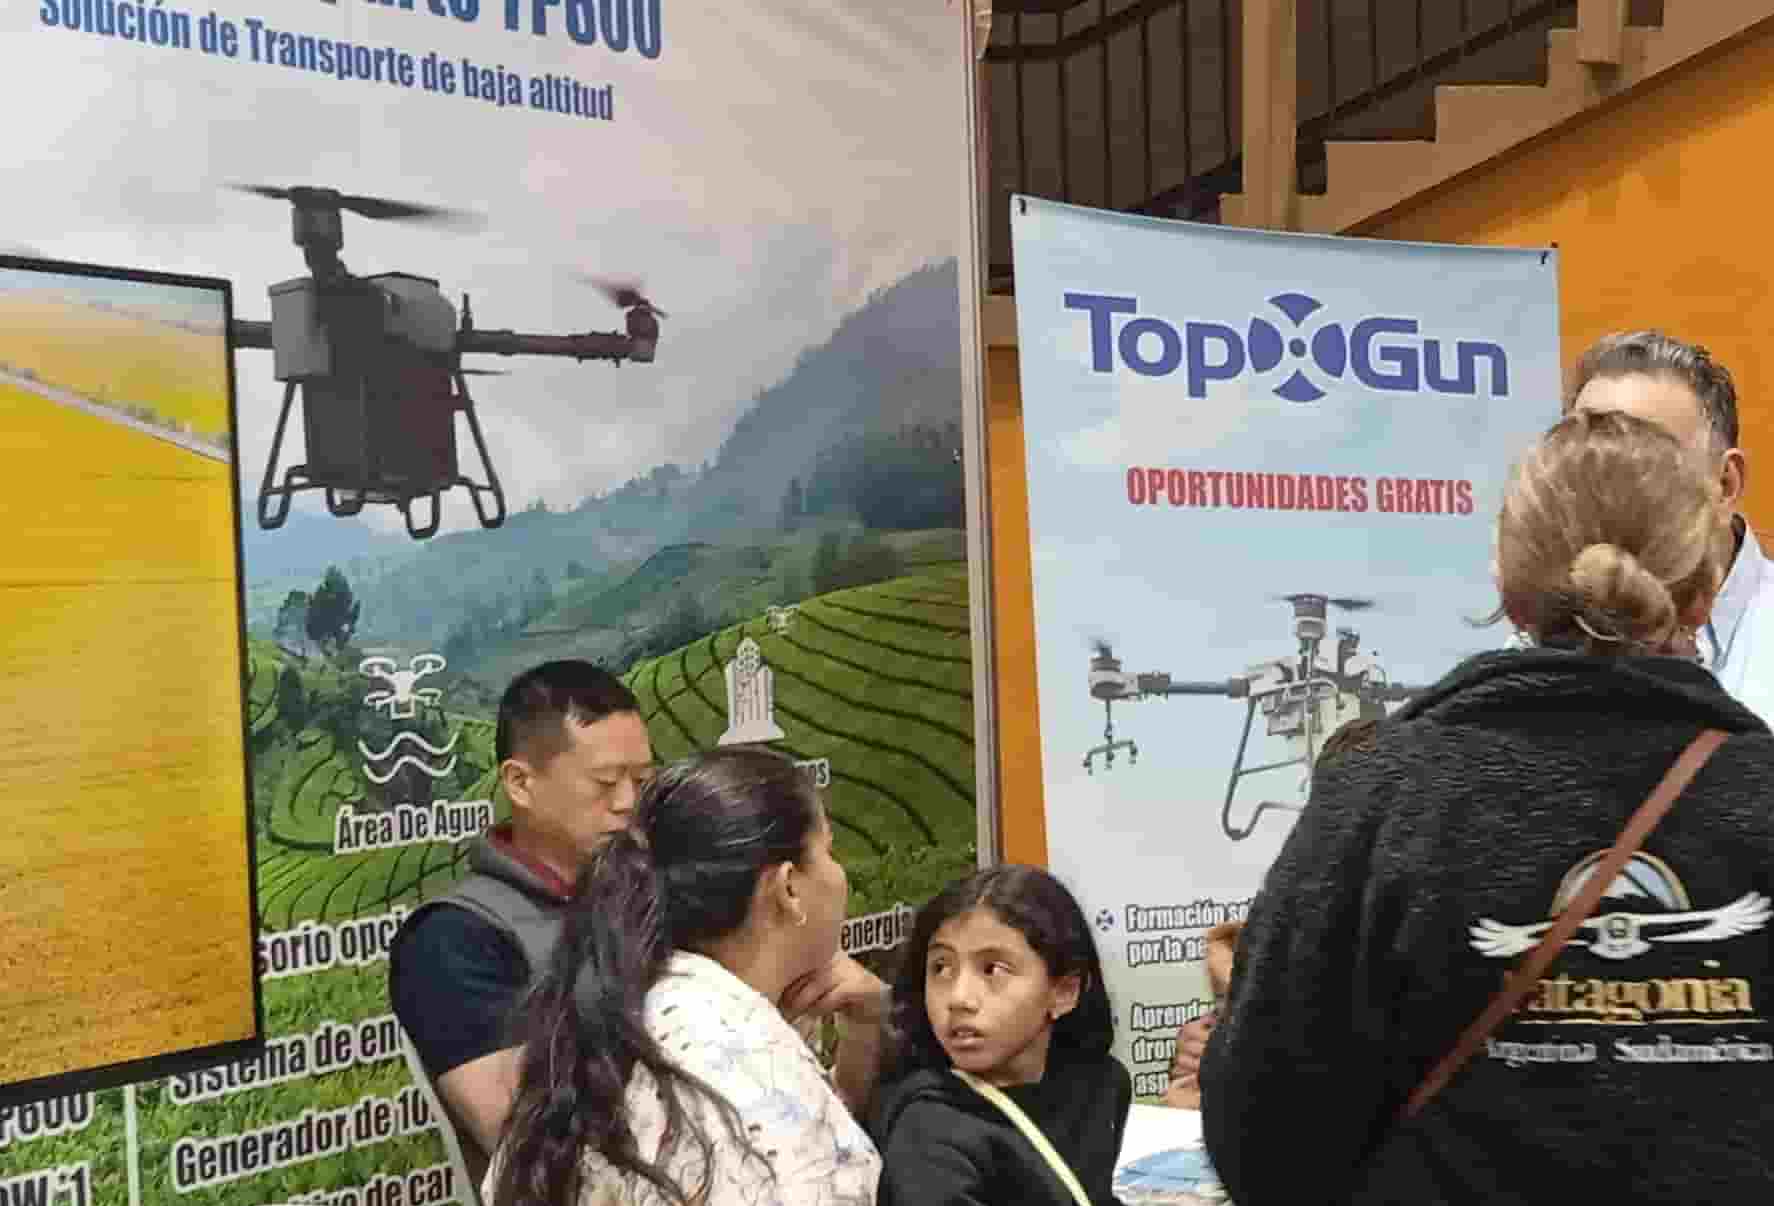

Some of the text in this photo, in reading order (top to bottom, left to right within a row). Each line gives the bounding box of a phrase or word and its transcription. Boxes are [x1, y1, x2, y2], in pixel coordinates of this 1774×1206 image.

[199, 12, 240, 58] de
[245, 18, 415, 87] Transporte
[421, 52, 456, 95] de
[462, 59, 522, 107] baja
[529, 73, 613, 121] altitud
[1127, 468, 1474, 516] OPORTUNIDADES GRATIS
[338, 803, 490, 848] Área De Agua
[341, 910, 404, 960] opc
[1126, 898, 1223, 932] Formación
[1128, 939, 1161, 968] por
[1162, 935, 1184, 962] la
[1130, 998, 1216, 1031] Aprend
[316, 1024, 352, 1067] de
[175, 1112, 348, 1188] Generador
[356, 1099, 391, 1142] de
